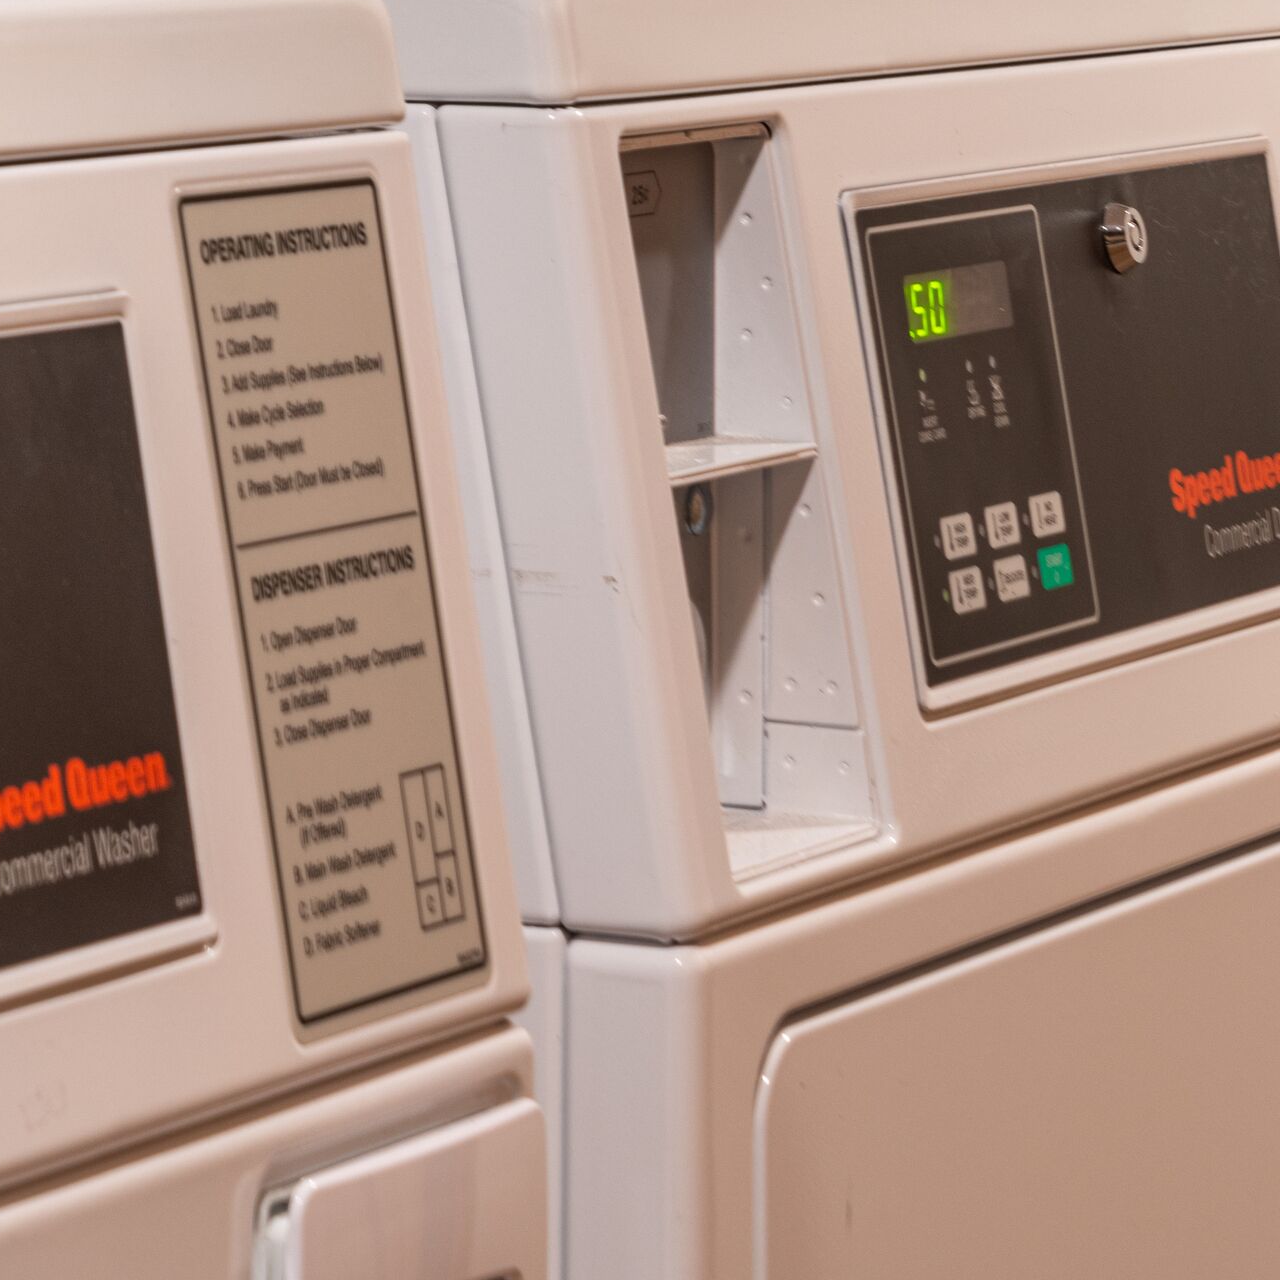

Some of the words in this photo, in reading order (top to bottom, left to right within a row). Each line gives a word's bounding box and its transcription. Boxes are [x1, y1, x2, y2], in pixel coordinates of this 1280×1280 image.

[200, 232, 275, 265] OPERATING
[275, 222, 368, 255] INSTRUCTIONS
[1169, 454, 1237, 520] Speed
[251, 564, 324, 602] DISPENSER
[323, 545, 416, 586] INSTRUCTIONS
[65, 751, 171, 812] Queen
[91, 821, 159, 869] Washer
